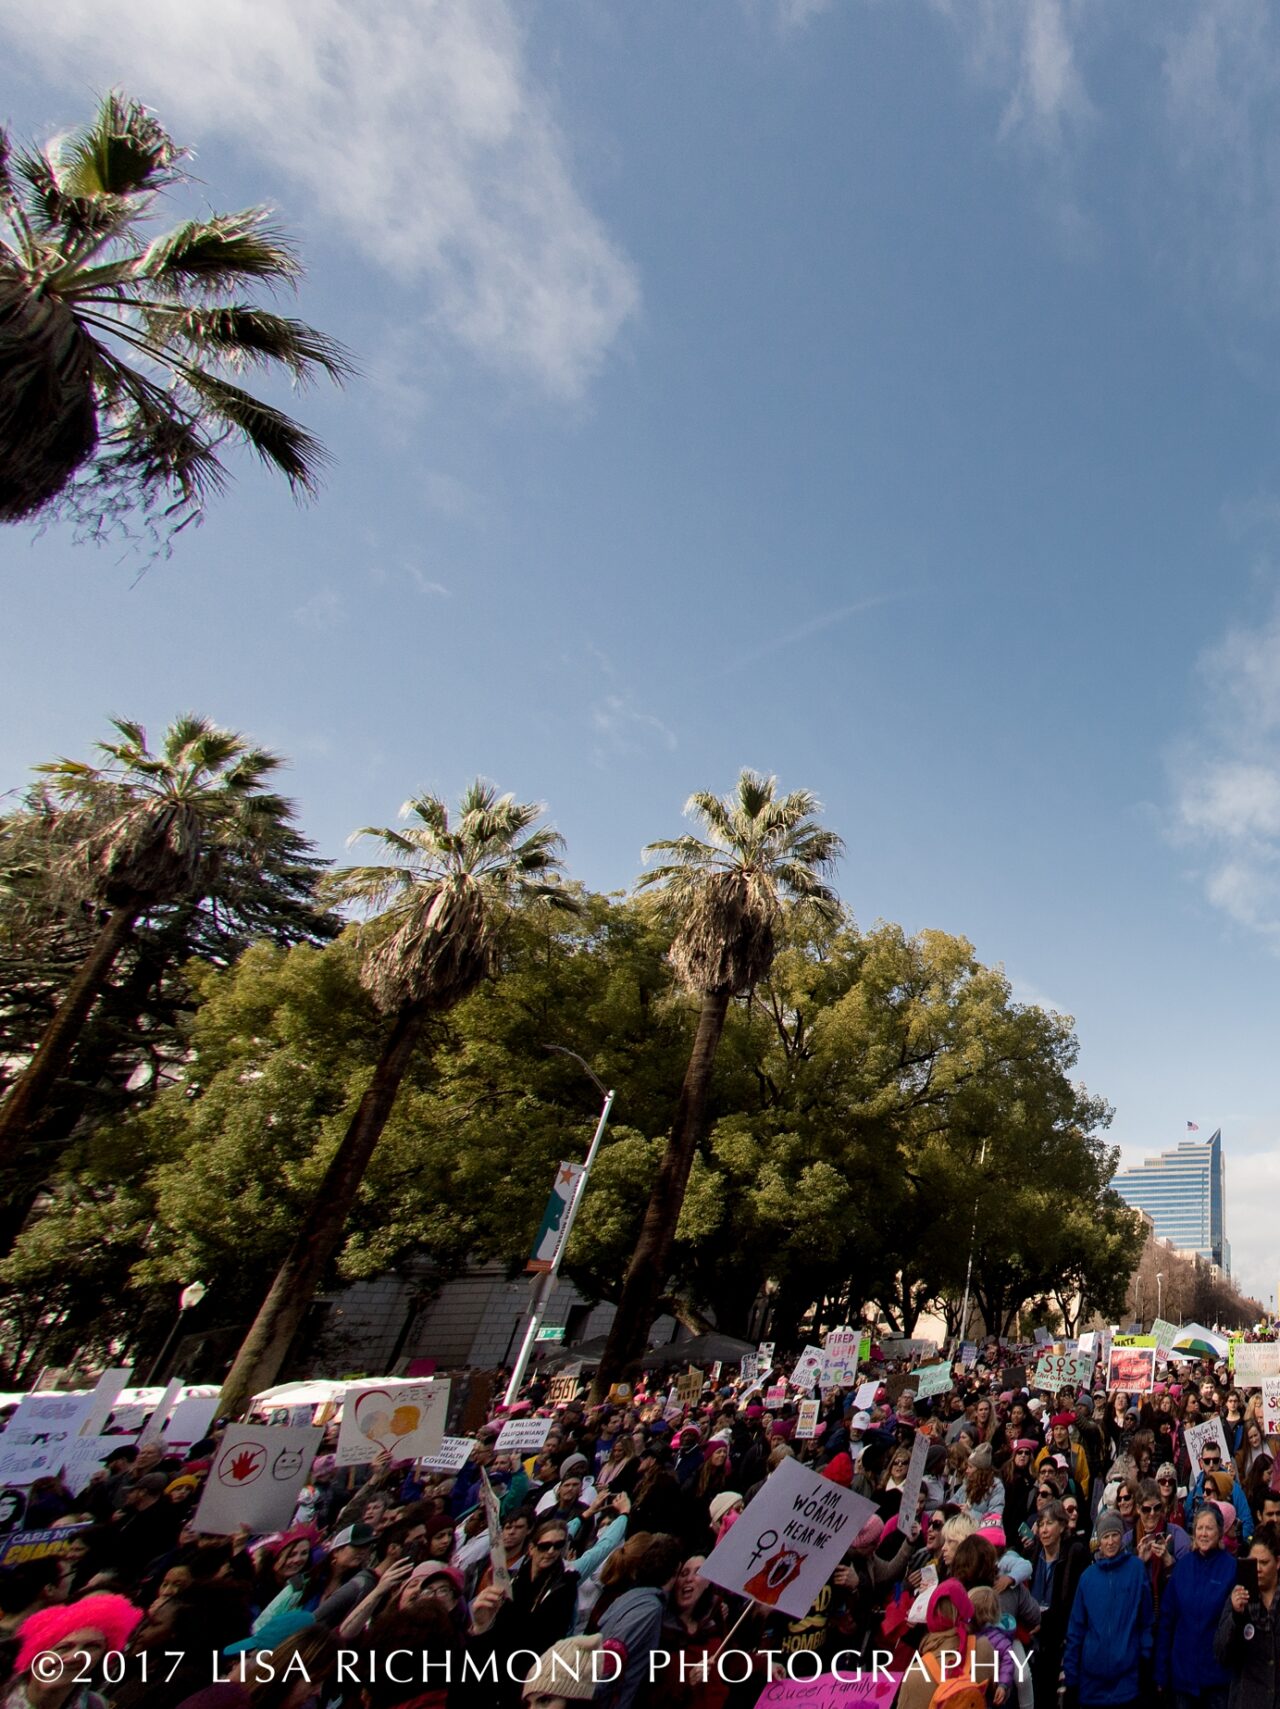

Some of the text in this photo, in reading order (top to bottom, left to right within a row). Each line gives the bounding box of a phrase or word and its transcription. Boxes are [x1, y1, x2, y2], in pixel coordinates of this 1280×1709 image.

[828, 1333, 855, 1344] FIRED
[548, 1377, 579, 1399] RESIST
[515, 1421, 542, 1429] MILLION
[454, 1439, 470, 1447] TAKE
[499, 1439, 515, 1447] CARE
[423, 1457, 459, 1467] COVERAGE
[440, 1452, 464, 1460] HEALTH
[811, 1484, 842, 1510] I AM
[792, 1493, 849, 1534] WOMAN
[11, 1527, 78, 1544] CARE NO
[783, 1519, 832, 1549] HEAR ME
[767, 1681, 827, 1702] Queer
